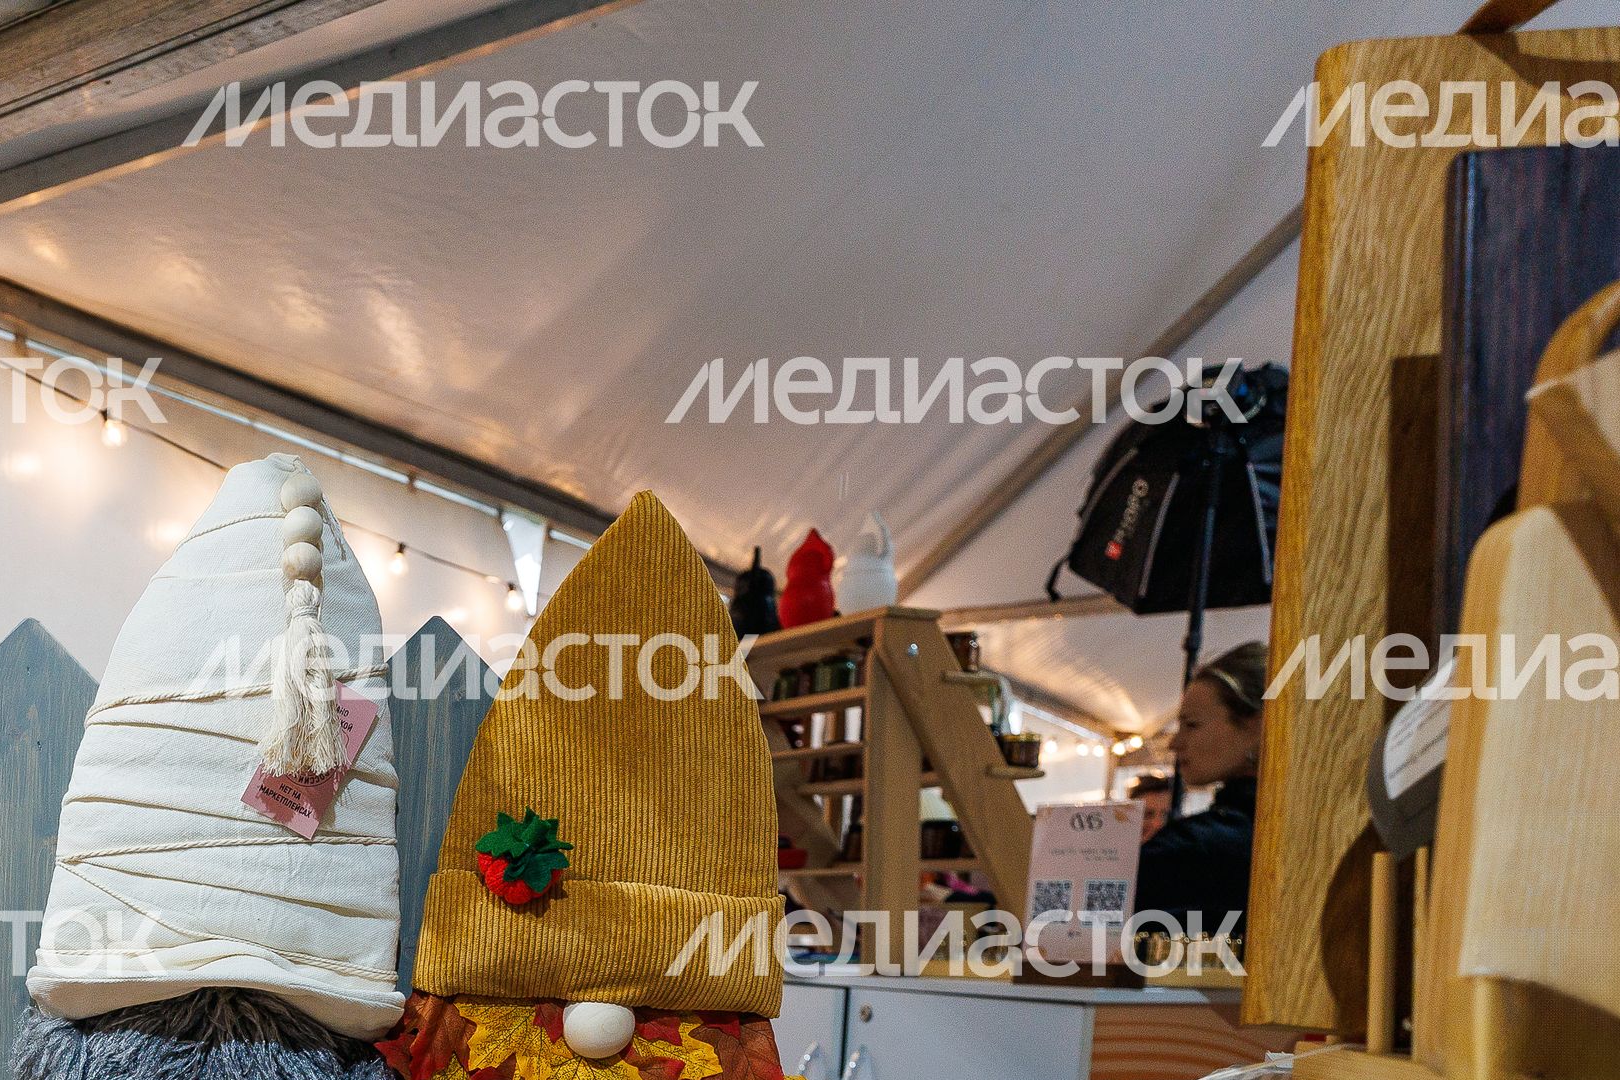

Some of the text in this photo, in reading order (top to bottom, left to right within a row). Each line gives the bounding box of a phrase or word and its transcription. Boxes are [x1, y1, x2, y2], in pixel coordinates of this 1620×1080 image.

[258, 785, 312, 819] МАРКЕТПЛЕЙСАХ
[279, 783, 302, 801] НЕТ НА
